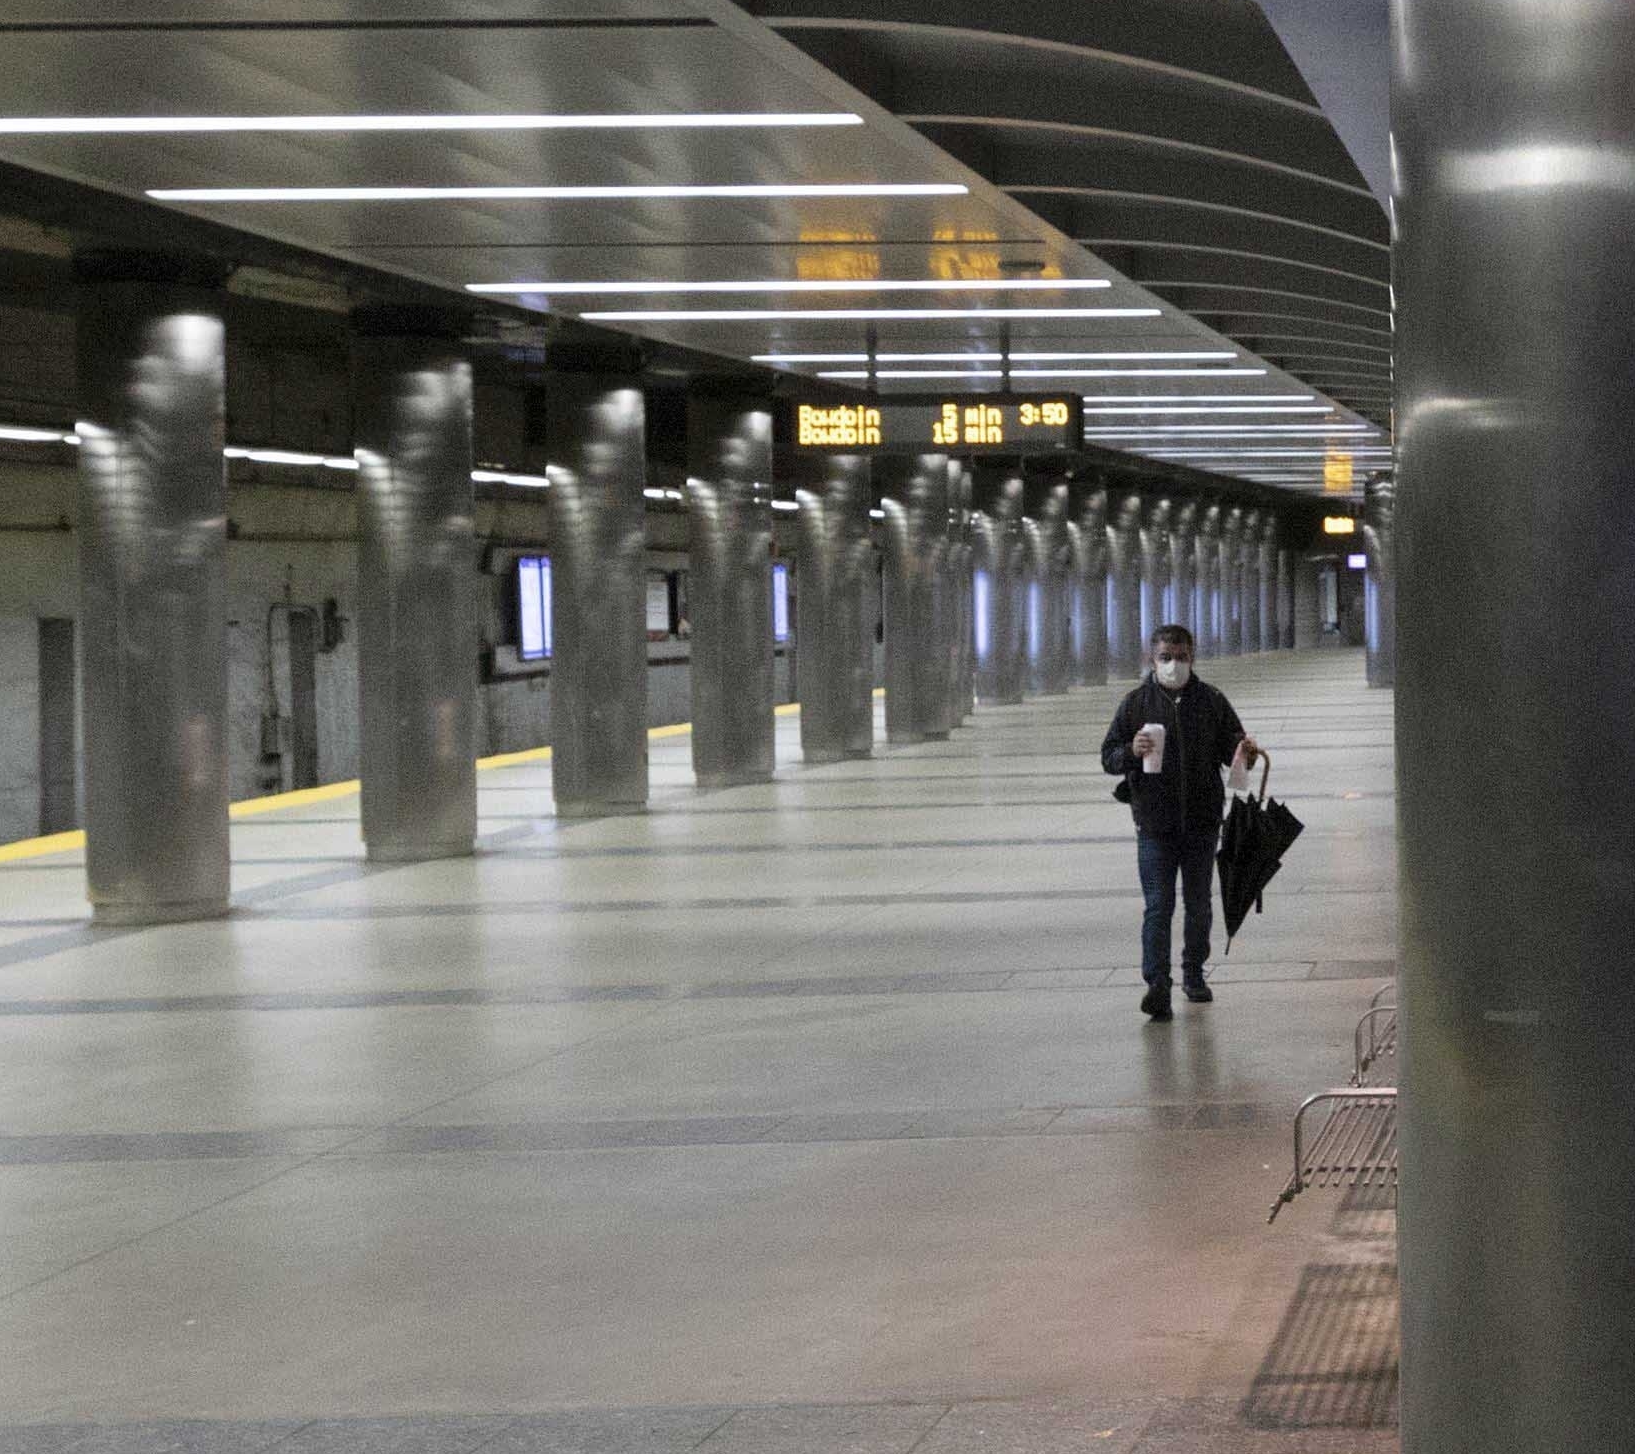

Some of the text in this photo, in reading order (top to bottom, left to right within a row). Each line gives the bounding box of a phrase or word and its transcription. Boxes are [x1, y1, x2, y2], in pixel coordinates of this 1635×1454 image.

[942, 403, 957, 424] 5
[964, 403, 1002, 425] min
[1019, 402, 1068, 425] 3:50
[932, 422, 958, 444] 15
[964, 424, 1002, 444] min
